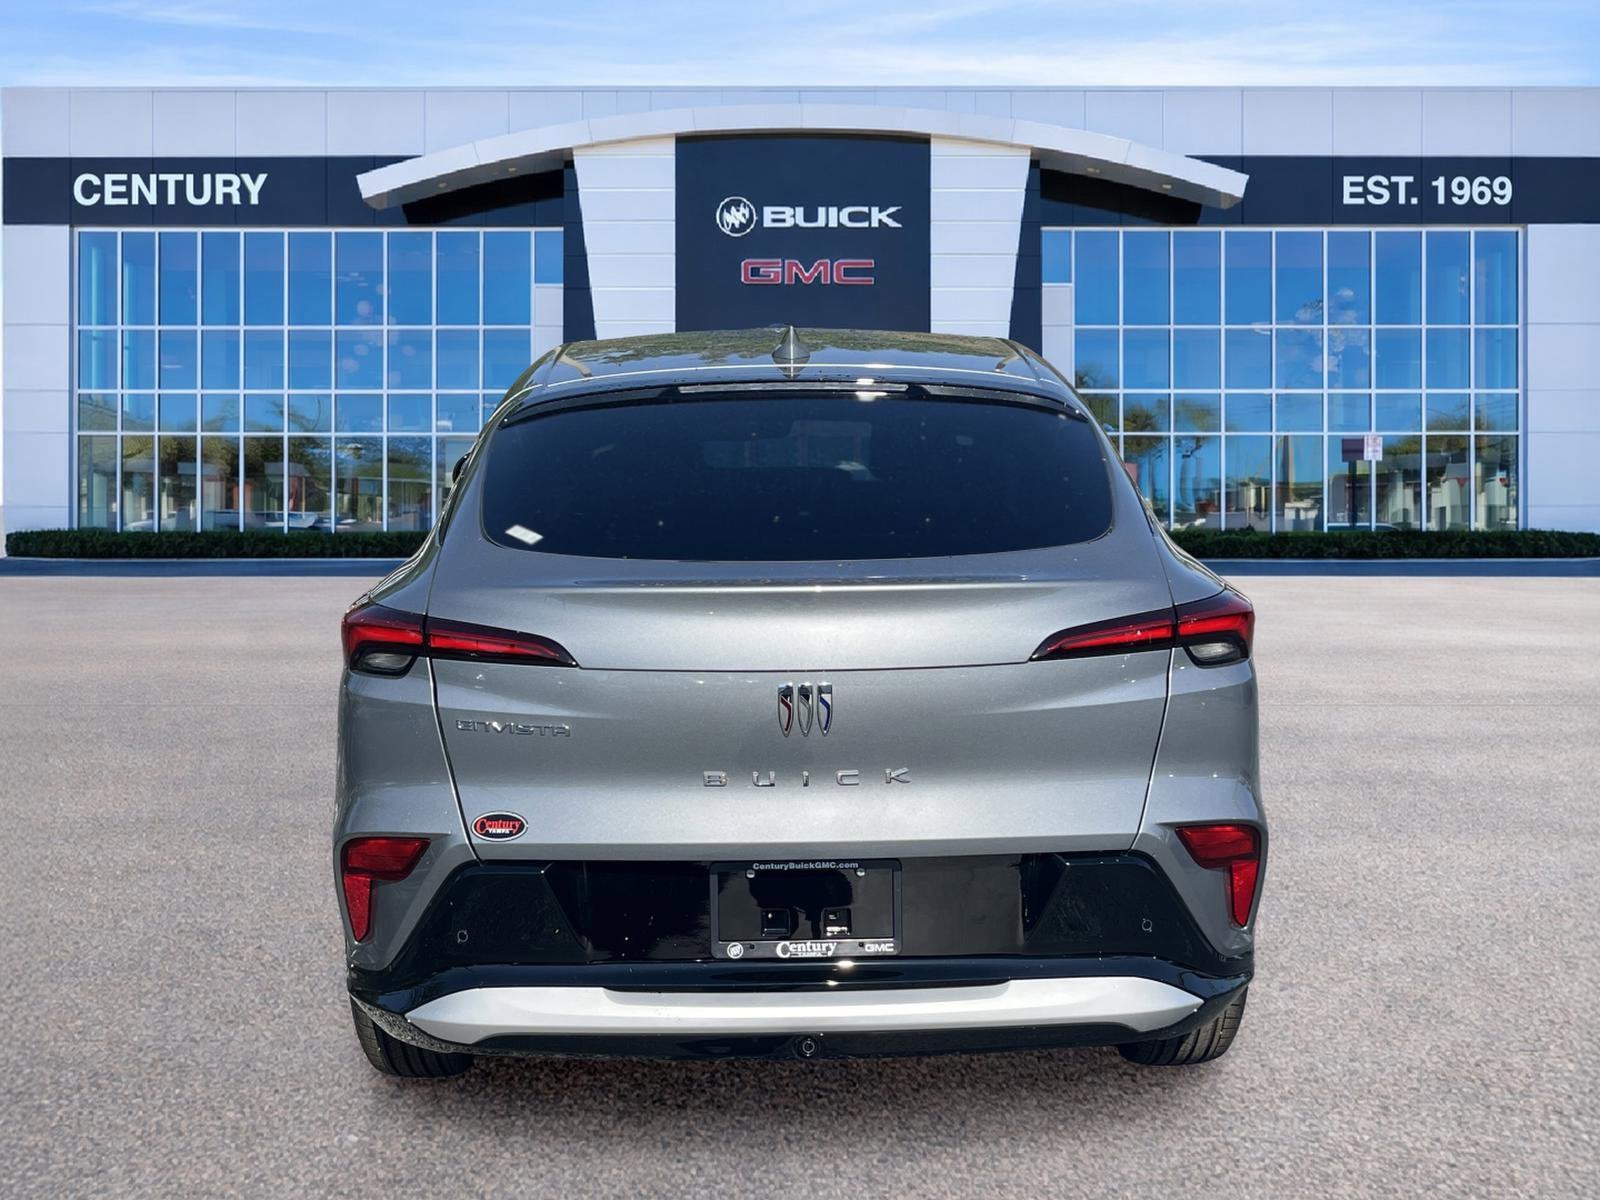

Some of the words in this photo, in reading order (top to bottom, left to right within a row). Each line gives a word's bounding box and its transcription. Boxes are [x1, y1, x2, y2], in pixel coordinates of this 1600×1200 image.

[73, 173, 269, 206] CENTURY
[1342, 174, 1419, 206] EST.
[1431, 175, 1513, 206] 1969
[762, 206, 903, 228] BUICK
[740, 258, 875, 285] GMC
[703, 767, 911, 788] BUICK
[475, 818, 521, 834] Century
[752, 861, 859, 871] CenturyBuickGMC.com
[775, 941, 837, 959] Century
[864, 943, 895, 952] GMC
